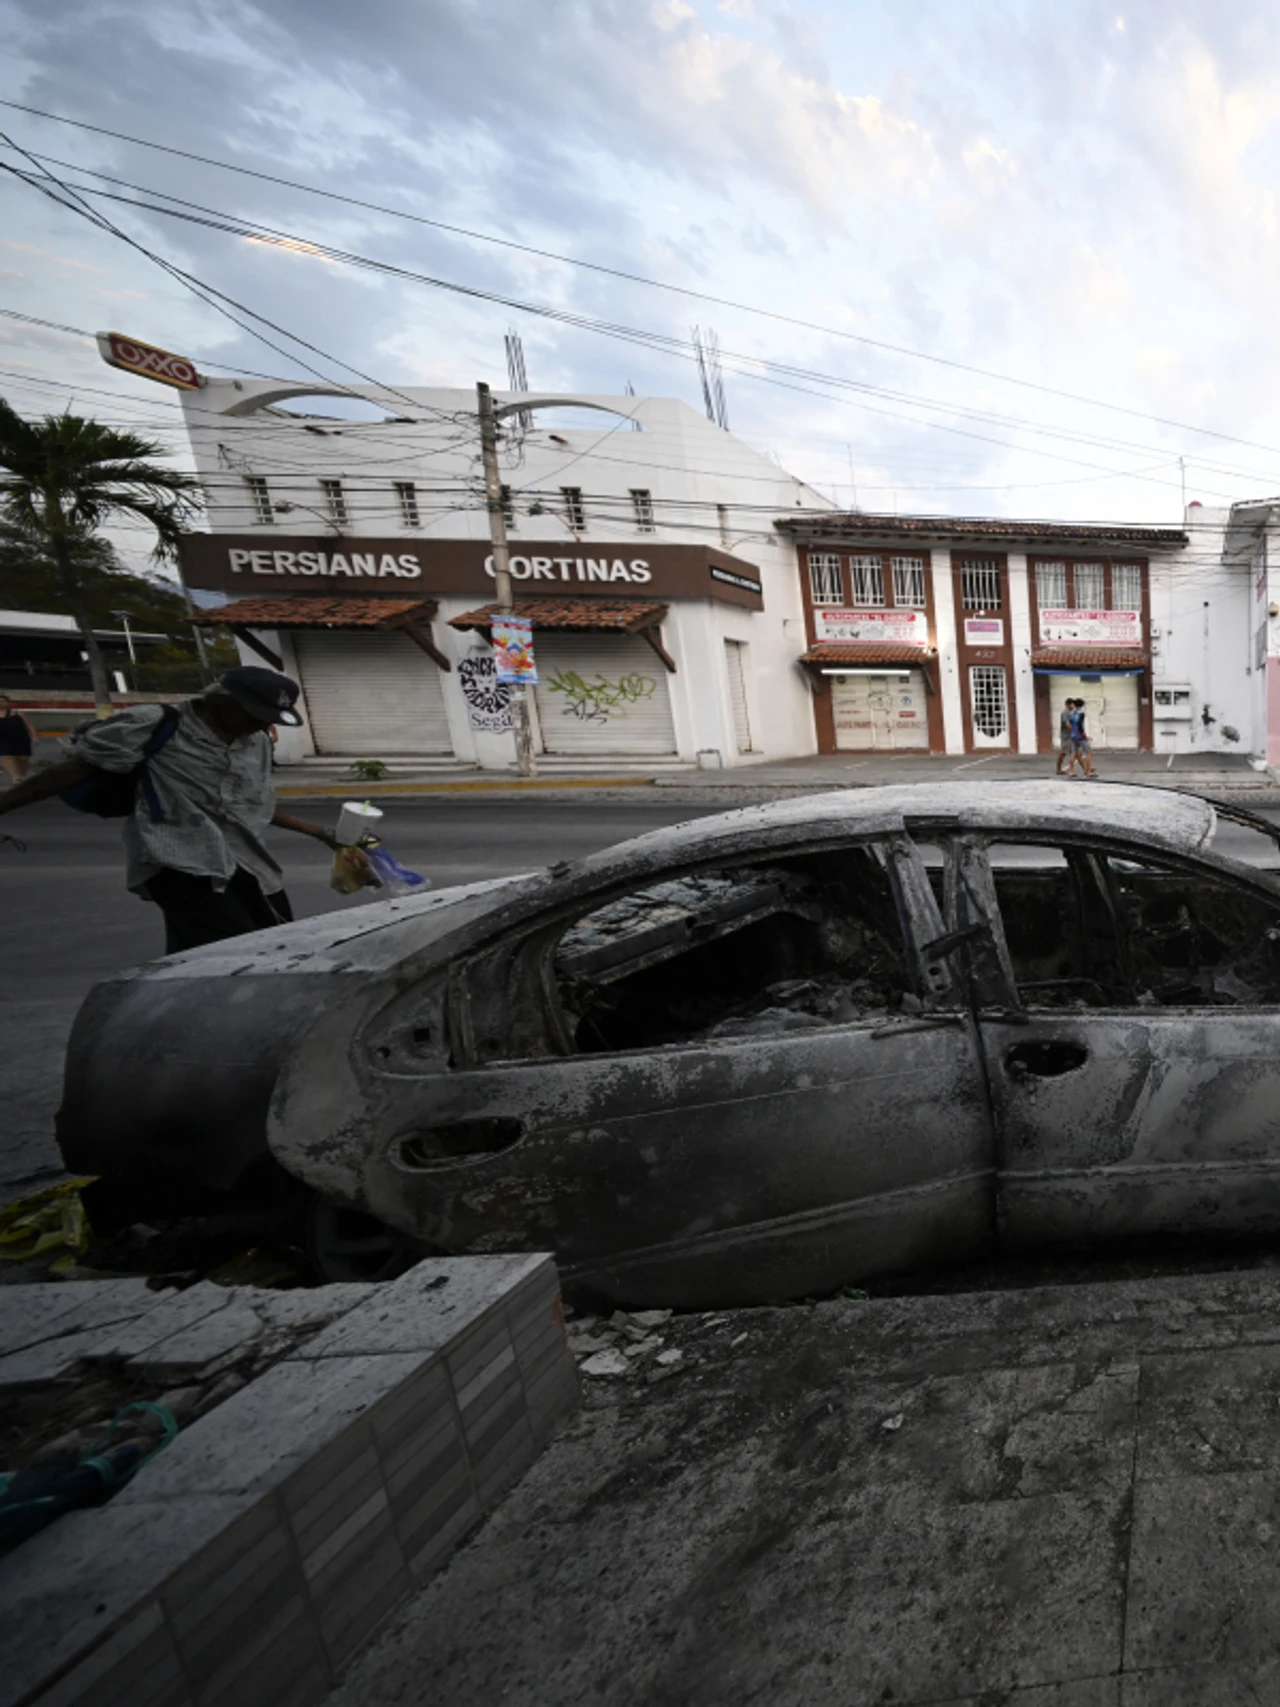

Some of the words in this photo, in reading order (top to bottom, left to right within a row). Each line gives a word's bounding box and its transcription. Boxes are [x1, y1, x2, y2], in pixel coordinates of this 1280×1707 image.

[116, 343, 193, 381] OXXO
[228, 549, 421, 577] PERSIANAS
[485, 556, 652, 582] CORTINAS
